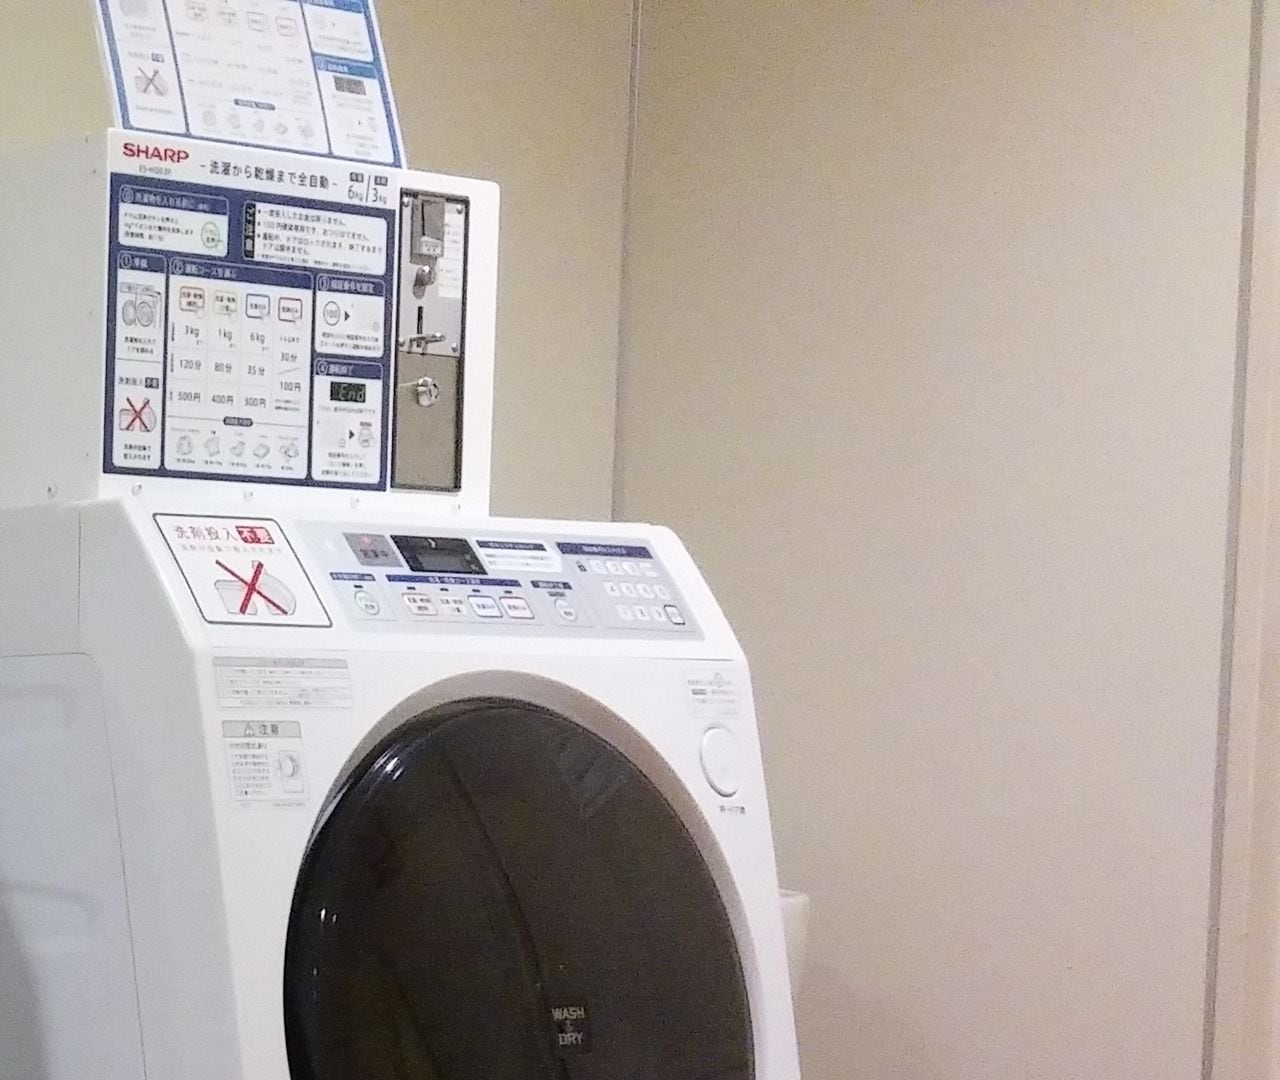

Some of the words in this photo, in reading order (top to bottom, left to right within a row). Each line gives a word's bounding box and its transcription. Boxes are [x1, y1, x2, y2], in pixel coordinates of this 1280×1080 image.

[122, 143, 189, 163] SHARP
[551, 1006, 585, 1020] WASH
[557, 1032, 584, 1046] DRY
